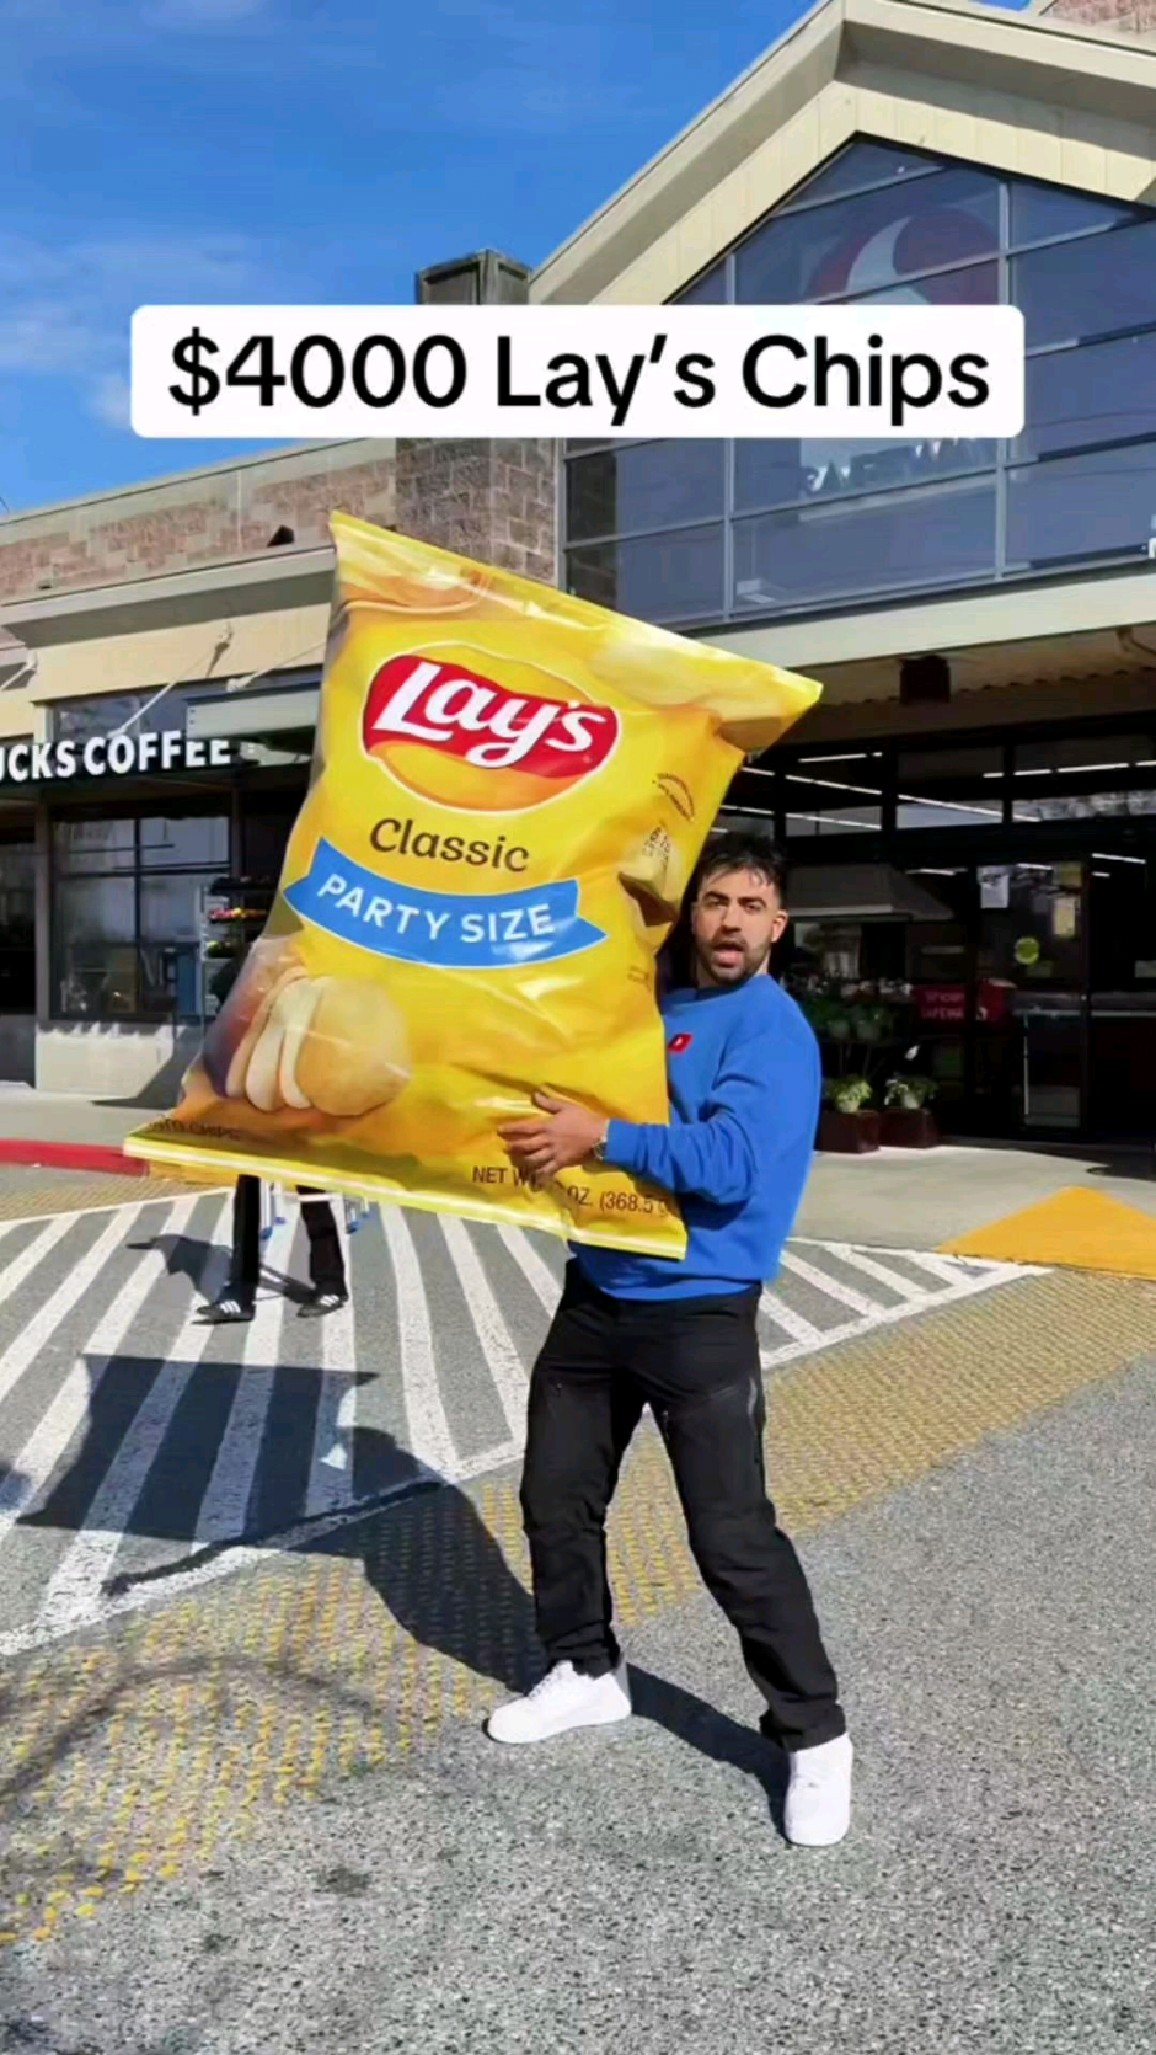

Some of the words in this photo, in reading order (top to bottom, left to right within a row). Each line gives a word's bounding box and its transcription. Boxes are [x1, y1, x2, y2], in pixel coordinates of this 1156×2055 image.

[372, 661, 606, 769] Lay's
[0, 741, 76, 782] CKS
[84, 730, 231, 775] COFFEE
[369, 817, 529, 872] Classic
[316, 873, 450, 941] PARTY
[460, 903, 556, 943] SIZE
[472, 1166, 508, 1184] NET
